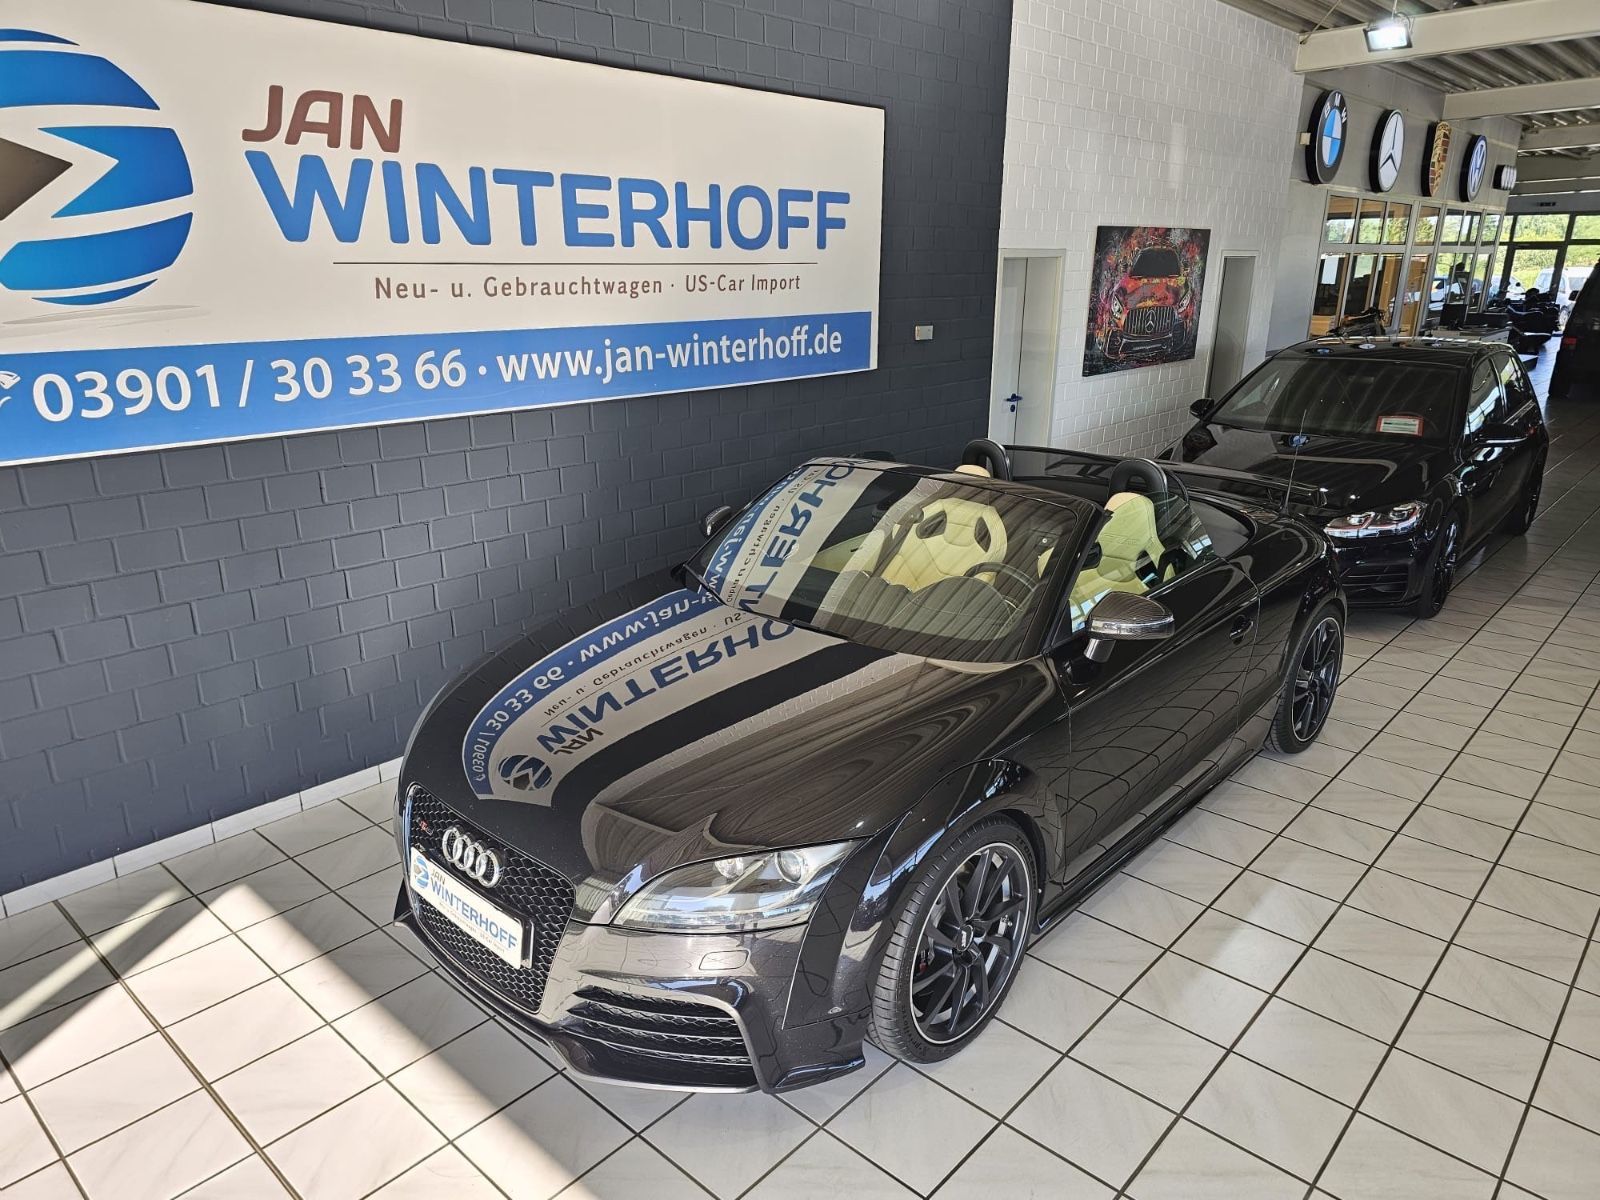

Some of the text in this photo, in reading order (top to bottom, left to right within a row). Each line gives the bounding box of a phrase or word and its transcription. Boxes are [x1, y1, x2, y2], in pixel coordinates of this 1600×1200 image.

[242, 85, 402, 153] JAN
[244, 150, 850, 251] WINTERHOFF
[375, 273, 801, 299] Neu- u. Gebrauchtwagen US-Car Import
[32, 364, 220, 422] 03901
[270, 357, 333, 402] 30
[346, 352, 402, 396] 33
[415, 349, 467, 390] 66
[496, 323, 842, 385] www.jan-winterhoff.de
[431, 868, 446, 886] JAN
[430, 876, 518, 949] WINTERHOFF
